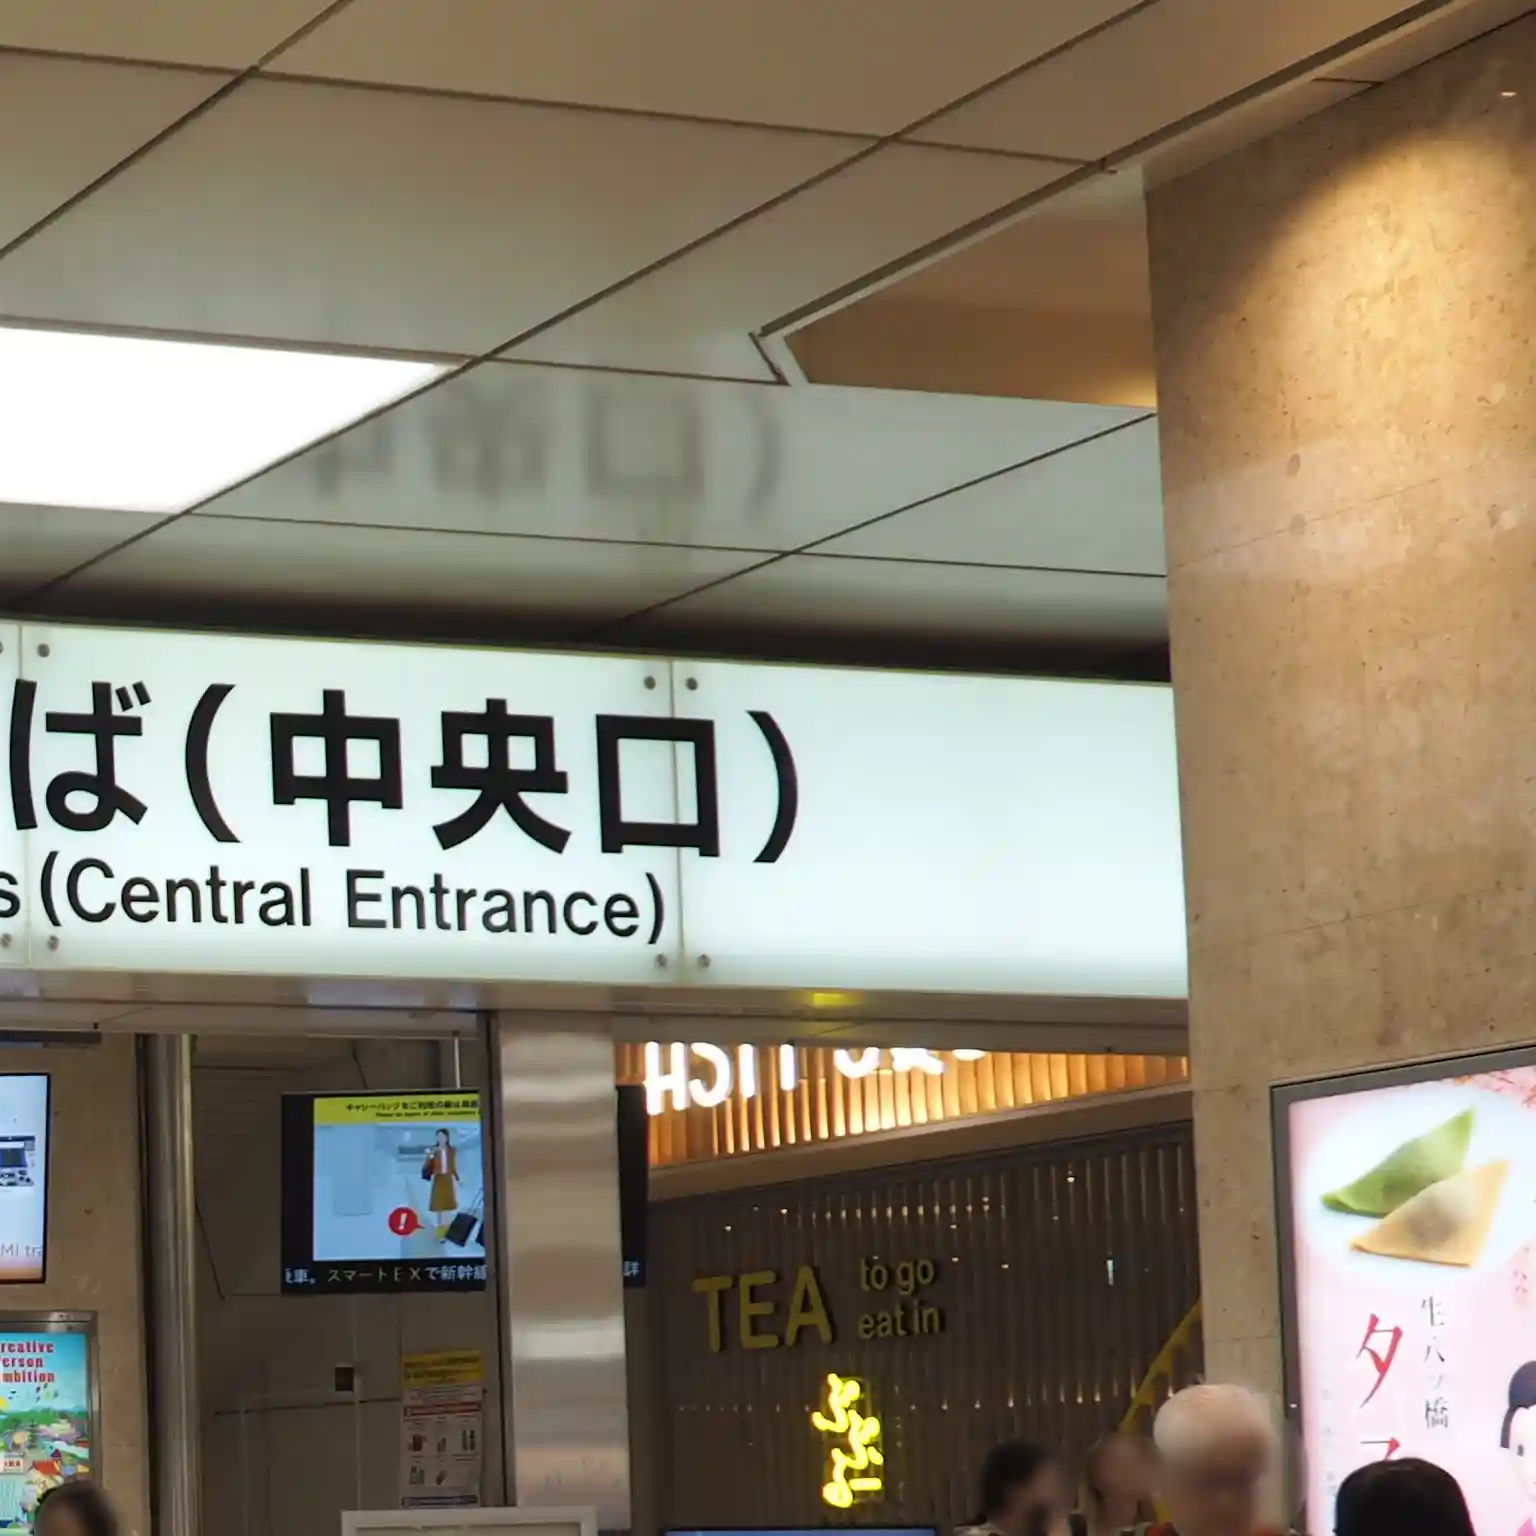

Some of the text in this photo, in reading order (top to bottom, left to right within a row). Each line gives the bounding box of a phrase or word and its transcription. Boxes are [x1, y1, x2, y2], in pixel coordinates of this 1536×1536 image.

[41, 852, 310, 926] (Central
[347, 870, 663, 944] Entrance)
[692, 1264, 833, 1353] TEA
[859, 1256, 935, 1296] to go
[858, 1299, 939, 1340] eat in
